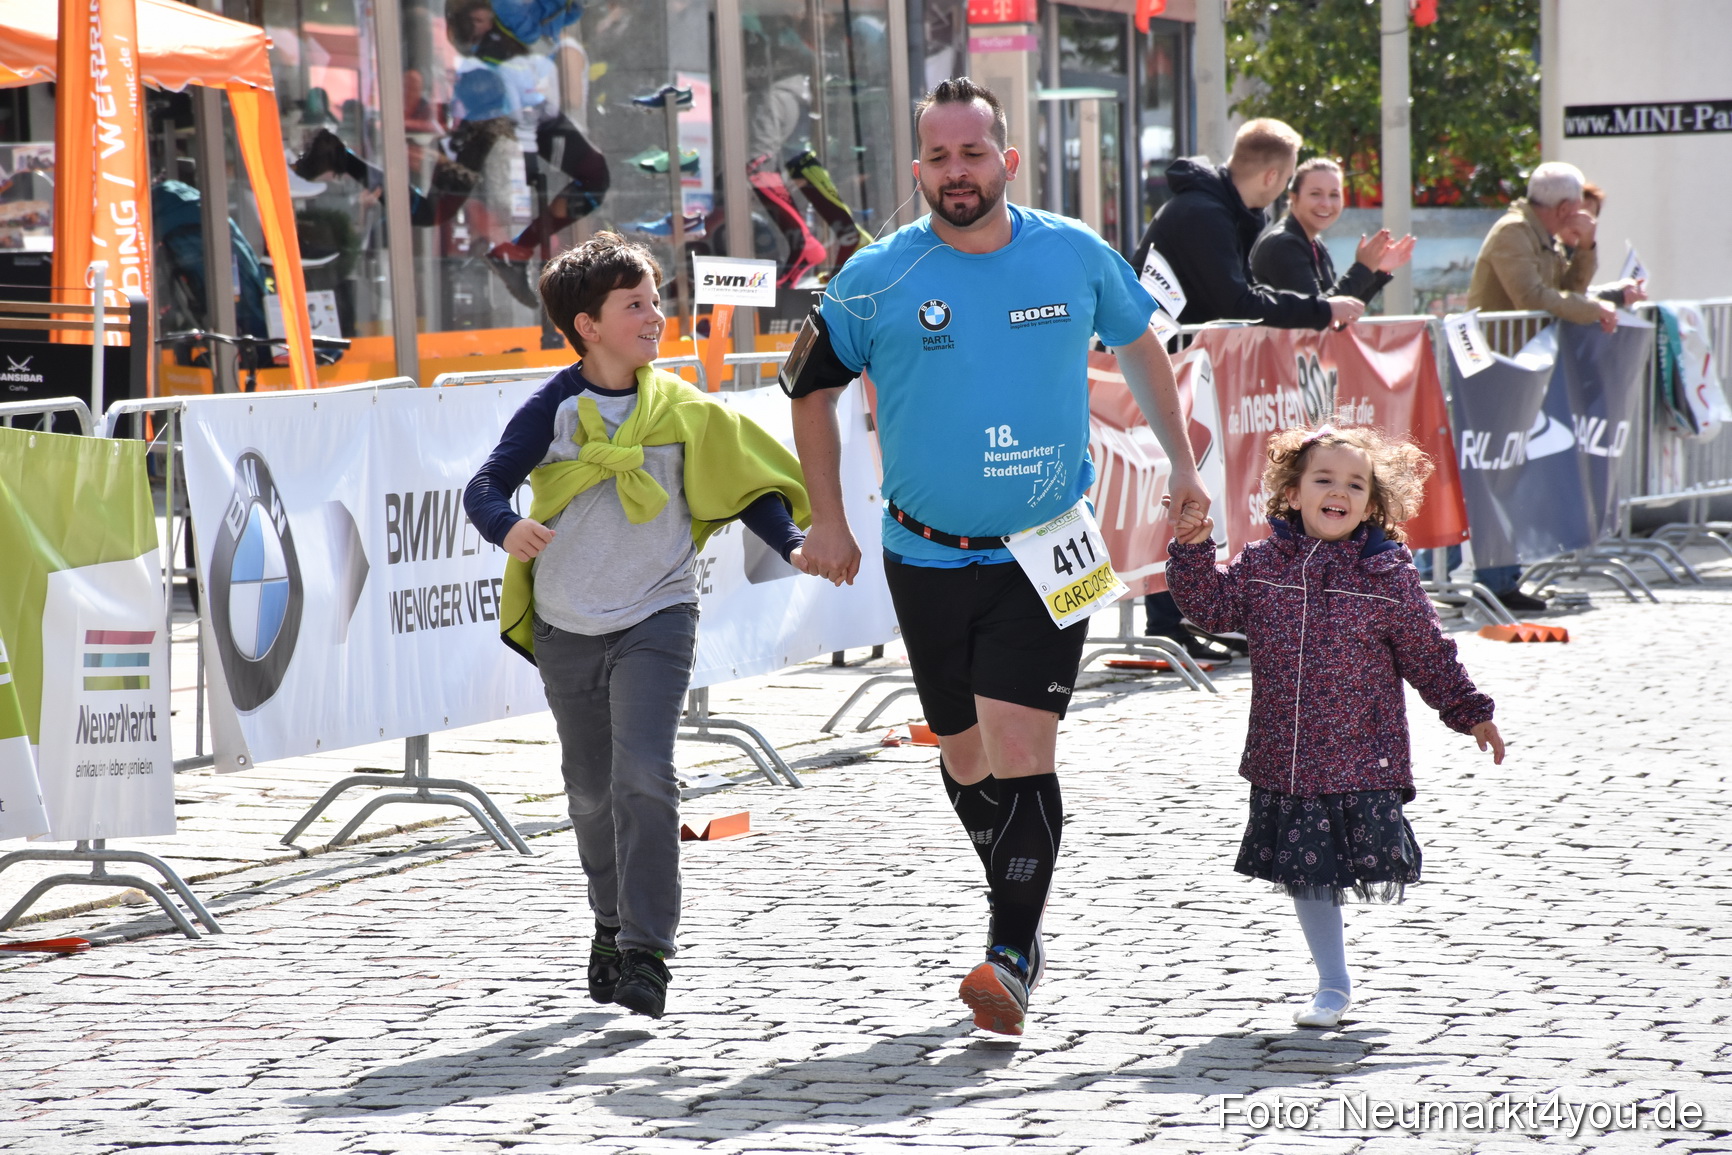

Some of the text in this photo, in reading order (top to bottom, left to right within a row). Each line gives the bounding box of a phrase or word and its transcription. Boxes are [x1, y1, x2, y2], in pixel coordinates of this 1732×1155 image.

[1565, 105, 1732, 134] www.MINI-Pa
[703, 274, 747, 287] swn
[1143, 264, 1171, 291] swn
[1010, 304, 1068, 323] BOCK
[922, 335, 955, 345] PARTL
[922, 343, 955, 352] Neumarkt
[1458, 323, 1474, 351] swn
[0, 373, 44, 383] ANSIBAR
[1240, 378, 1305, 434] meisten
[1356, 396, 1375, 425] die
[985, 425, 1019, 448] 18.
[984, 446, 1055, 462] Neumarkter
[983, 461, 1043, 477] Stadtlauf
[225, 458, 287, 543] BMW
[1037, 474, 1057, 502] September
[1046, 508, 1080, 532] BOCK
[1053, 531, 1096, 576] 411
[1054, 567, 1114, 613] CARDOSO
[389, 583, 463, 635] WENIGER
[76, 702, 157, 745] NeuerMarkt
[1005, 872, 1033, 883] cep
